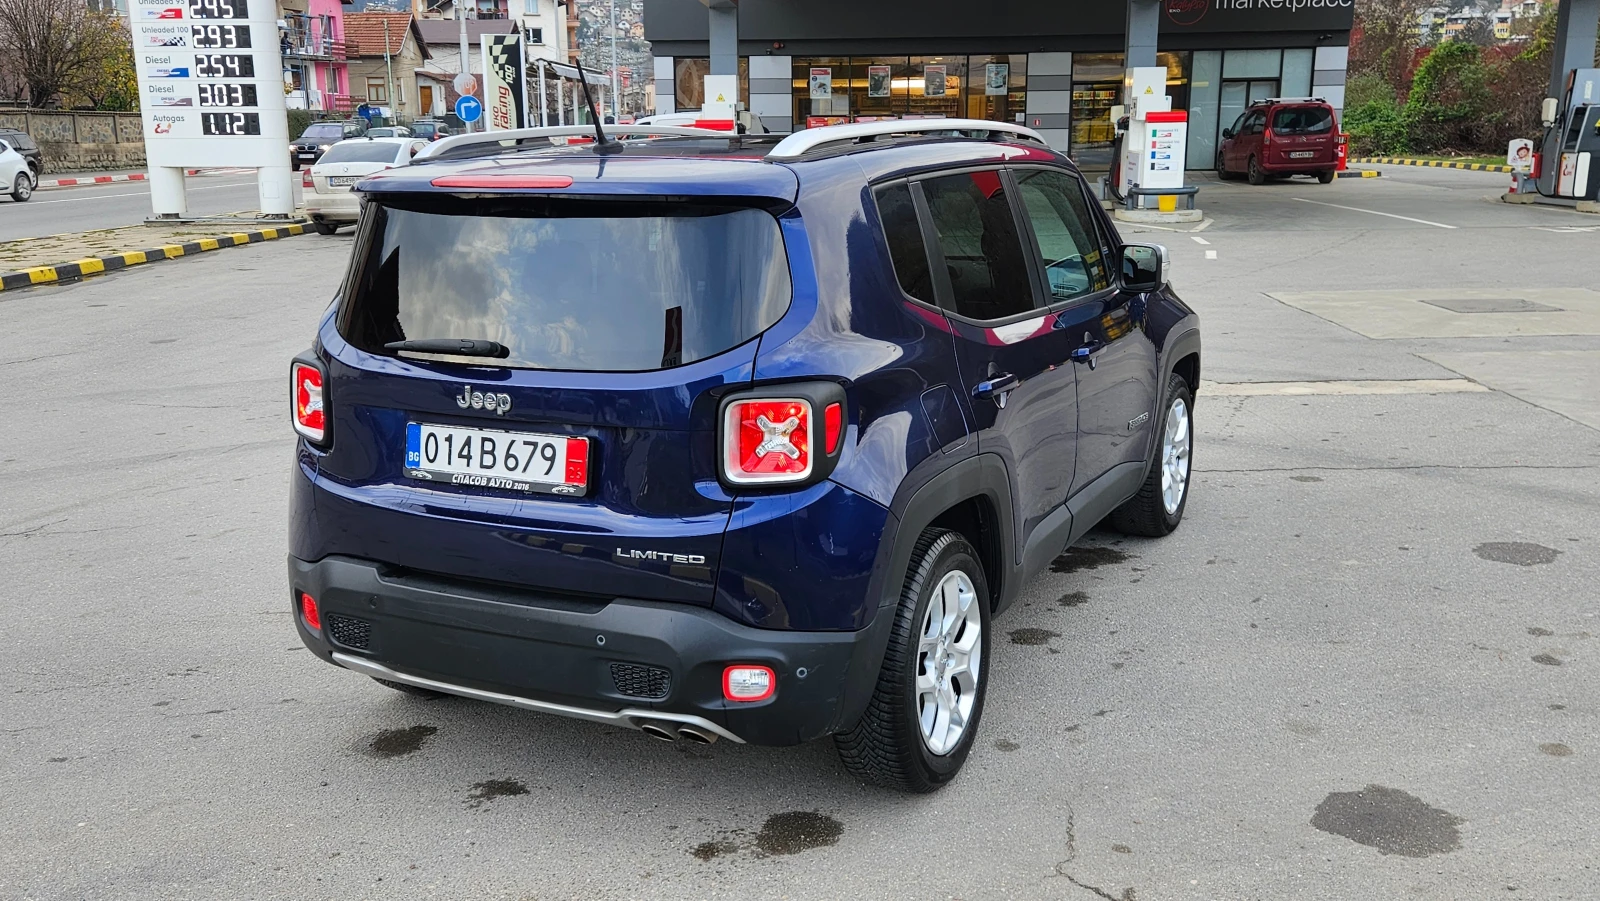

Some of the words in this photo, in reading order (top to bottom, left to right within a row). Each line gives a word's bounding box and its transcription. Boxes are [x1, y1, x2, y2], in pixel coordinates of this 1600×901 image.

[190, 0, 233, 18] 2.45
[193, 25, 236, 48] 2.93
[145, 56, 171, 64] Diesel
[196, 54, 240, 77] 2.54
[505, 65, 513, 84] 100
[148, 85, 174, 93] Diesel
[199, 84, 243, 107] 3.03
[498, 85, 510, 130] racing
[153, 115, 185, 123] Autogas
[210, 113, 245, 135] 1.12
[456, 385, 512, 416] Jeep
[408, 451, 420, 462] BG
[424, 432, 557, 476] 014B679
[451, 474, 488, 486] СПАСОВ
[489, 478, 513, 489] АУТО
[513, 482, 530, 490] 2016
[616, 547, 706, 564] LIMITED
